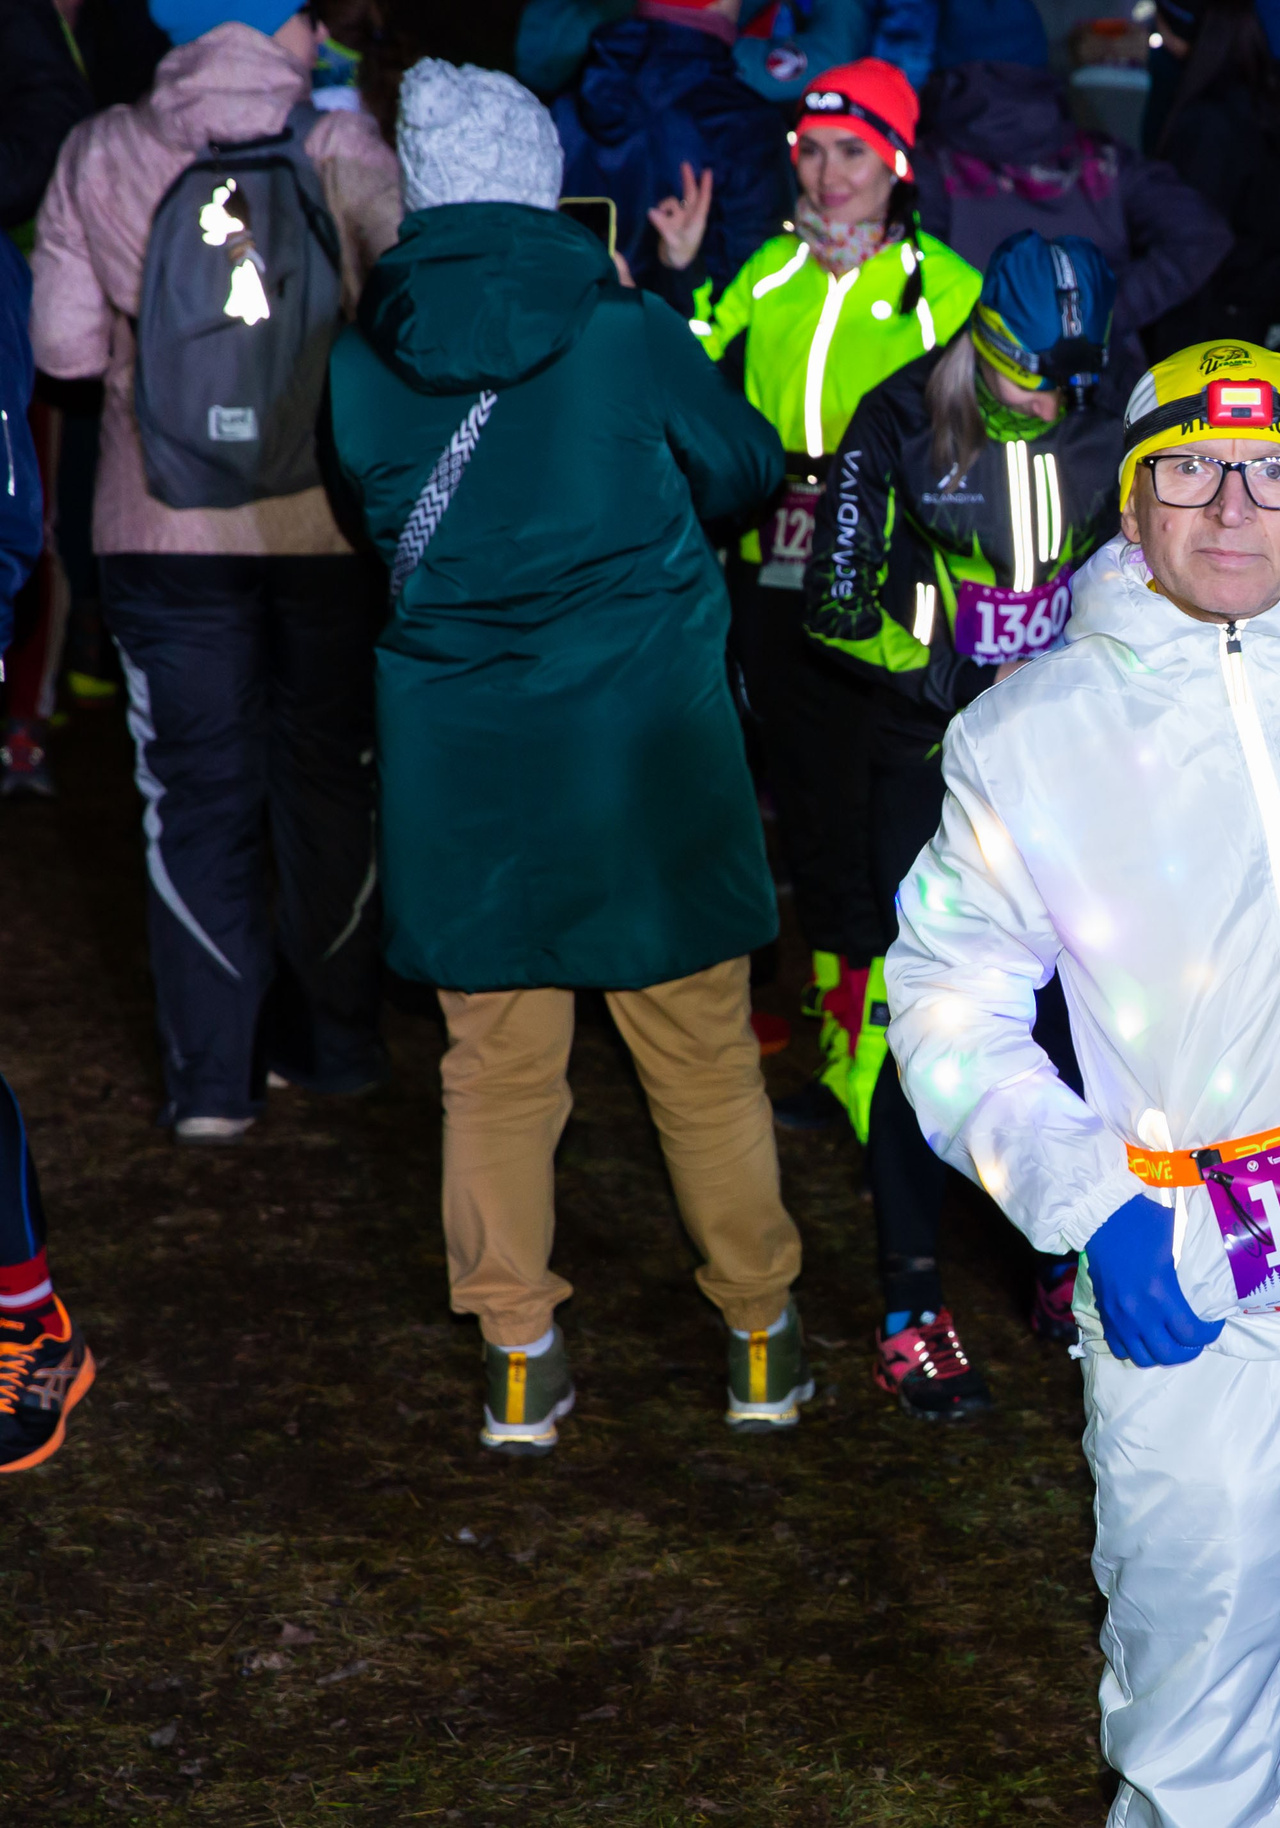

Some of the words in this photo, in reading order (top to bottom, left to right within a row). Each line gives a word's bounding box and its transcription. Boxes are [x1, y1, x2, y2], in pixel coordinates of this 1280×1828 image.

[770, 507, 816, 558] 12
[831, 450, 863, 599] SCANDIVA
[974, 586, 1069, 655] 1360
